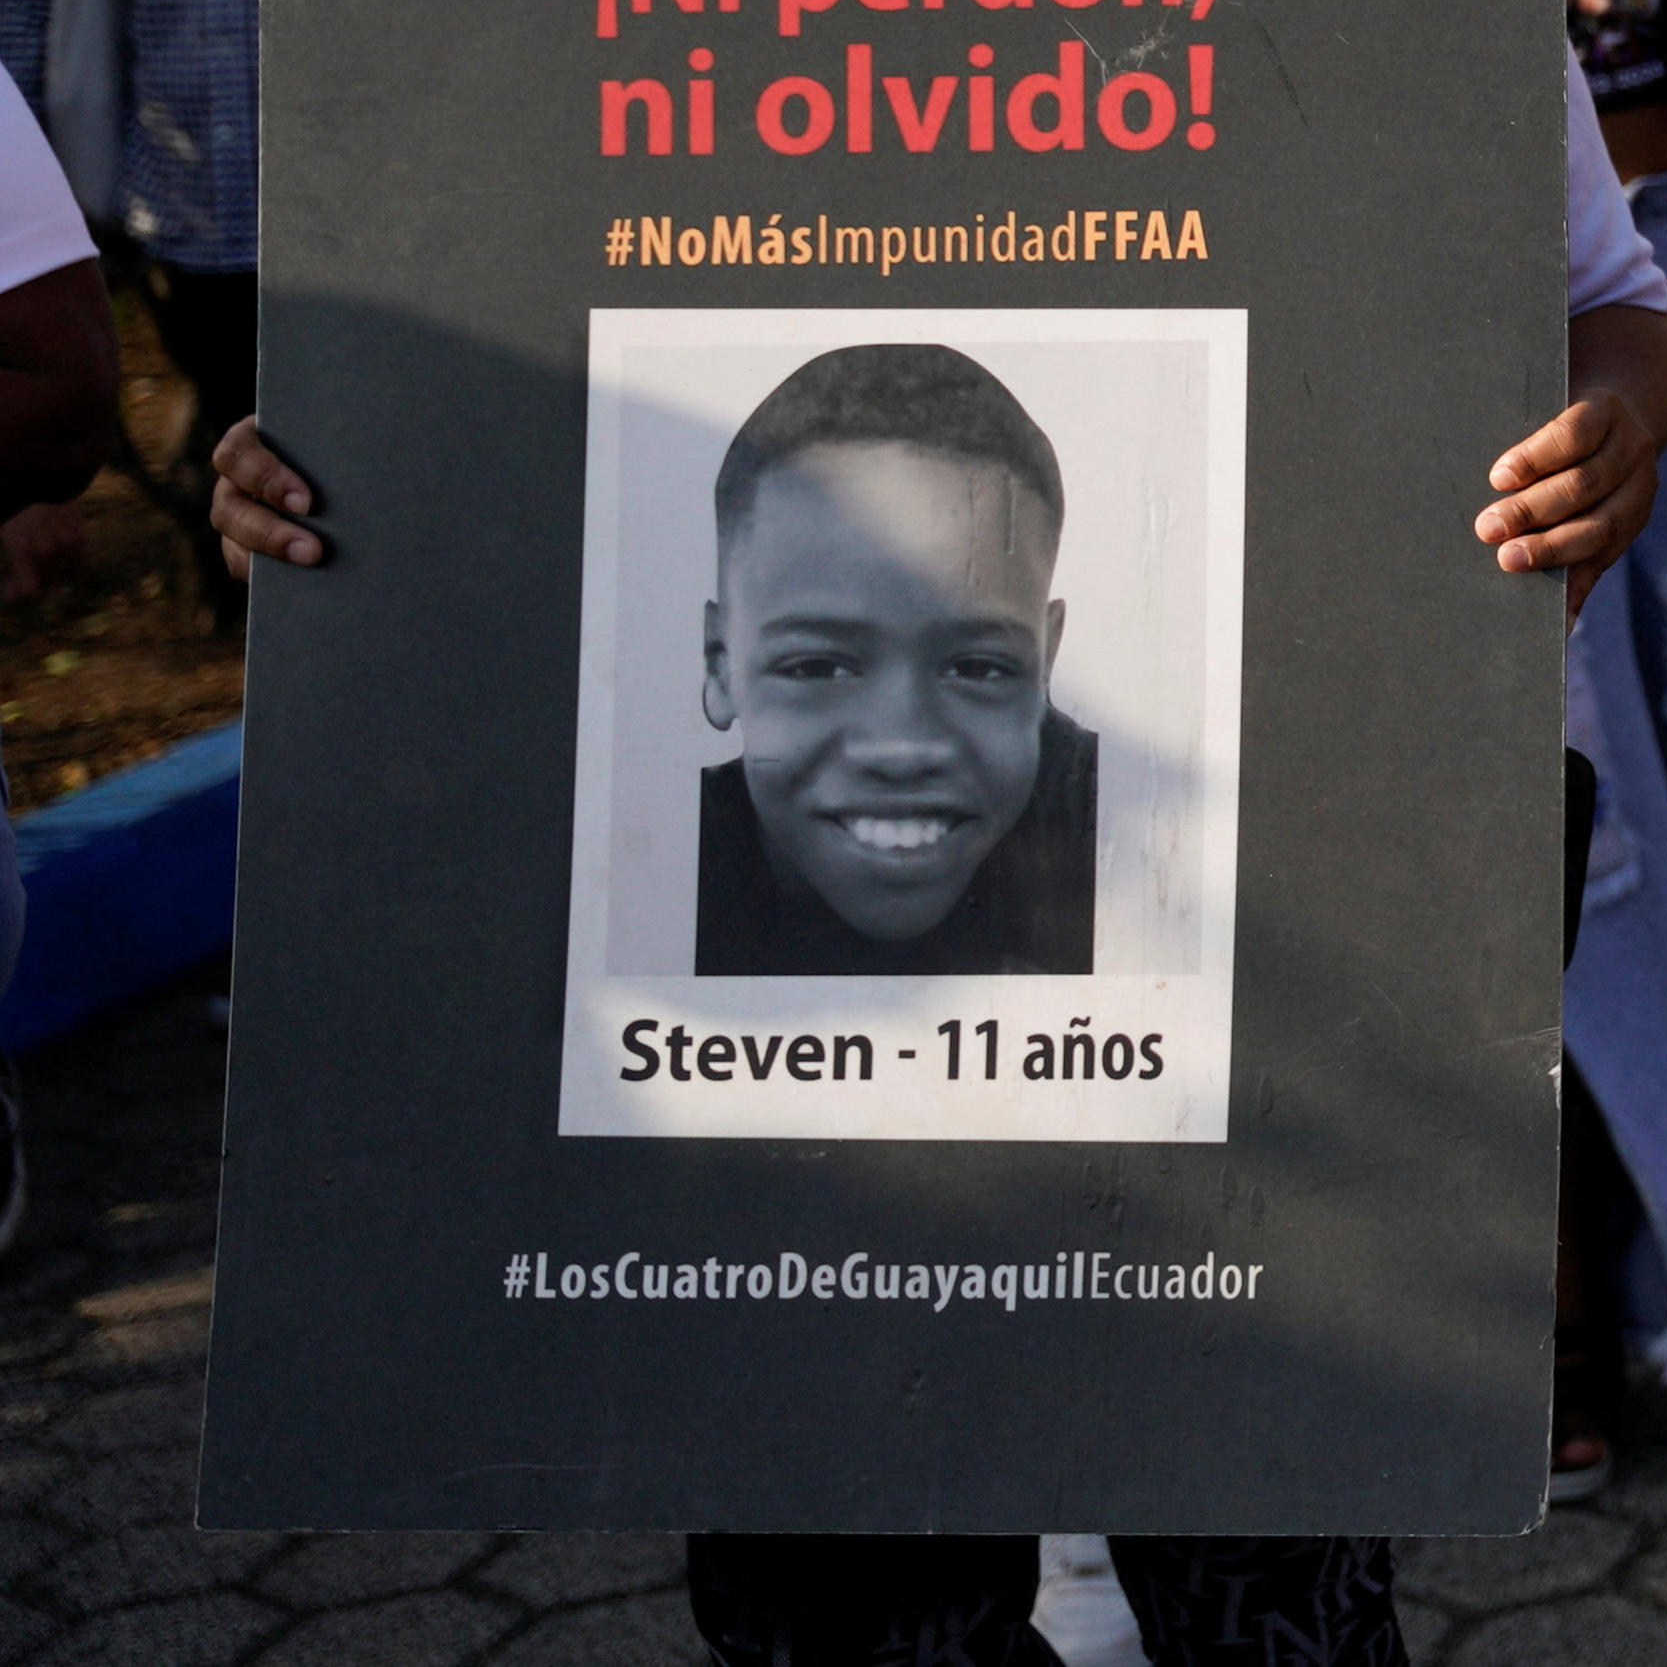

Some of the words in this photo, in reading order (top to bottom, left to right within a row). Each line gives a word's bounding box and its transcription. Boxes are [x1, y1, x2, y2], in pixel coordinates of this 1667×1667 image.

[600, 48, 714, 156] ni
[756, 40, 1217, 156] olvido!
[604, 209, 1209, 277] #NoMásImpunidadFFAA
[619, 1019, 873, 1082] Steven
[937, 1019, 998, 1080] 11
[1023, 1016, 1164, 1081] años
[503, 1250, 1264, 1313] #LosCuatroDeGuayaquilEcuador
